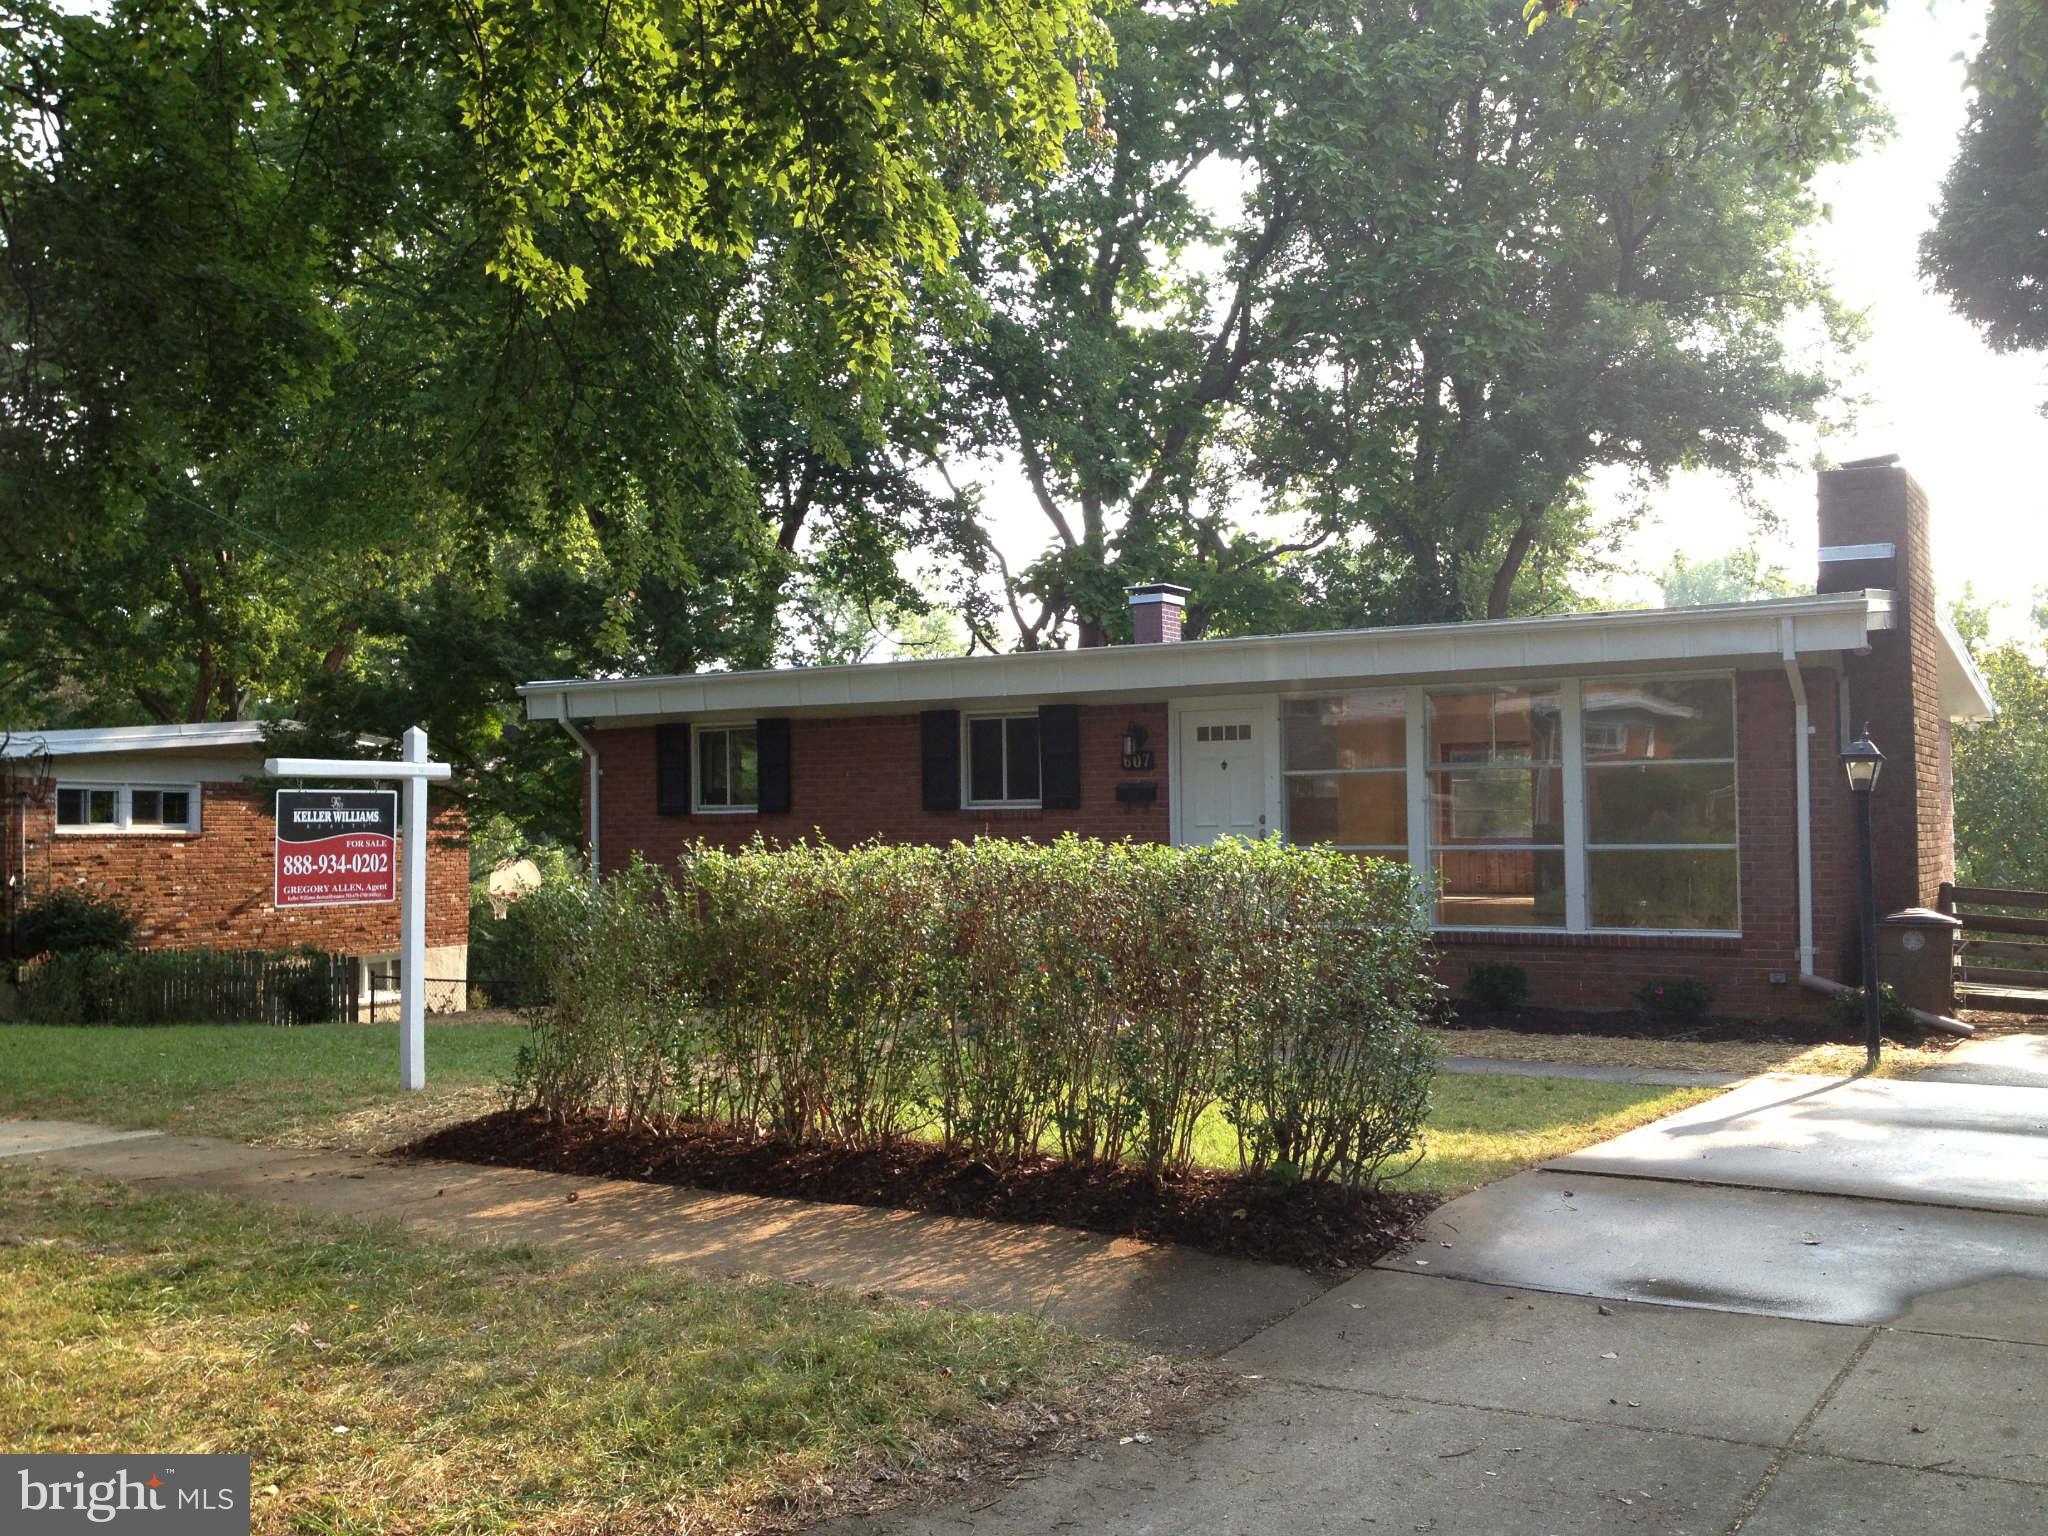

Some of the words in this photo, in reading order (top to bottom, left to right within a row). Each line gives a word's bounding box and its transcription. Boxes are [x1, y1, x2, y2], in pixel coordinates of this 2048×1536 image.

[293, 811, 331, 823] KELLER
[332, 811, 380, 823] WILLIAMS
[365, 839, 387, 847] SALE
[283, 853, 388, 875] 888-934-0202
[283, 884, 330, 895] GREGORY
[331, 883, 364, 892] ALLEN,
[366, 883, 387, 891] Agent
